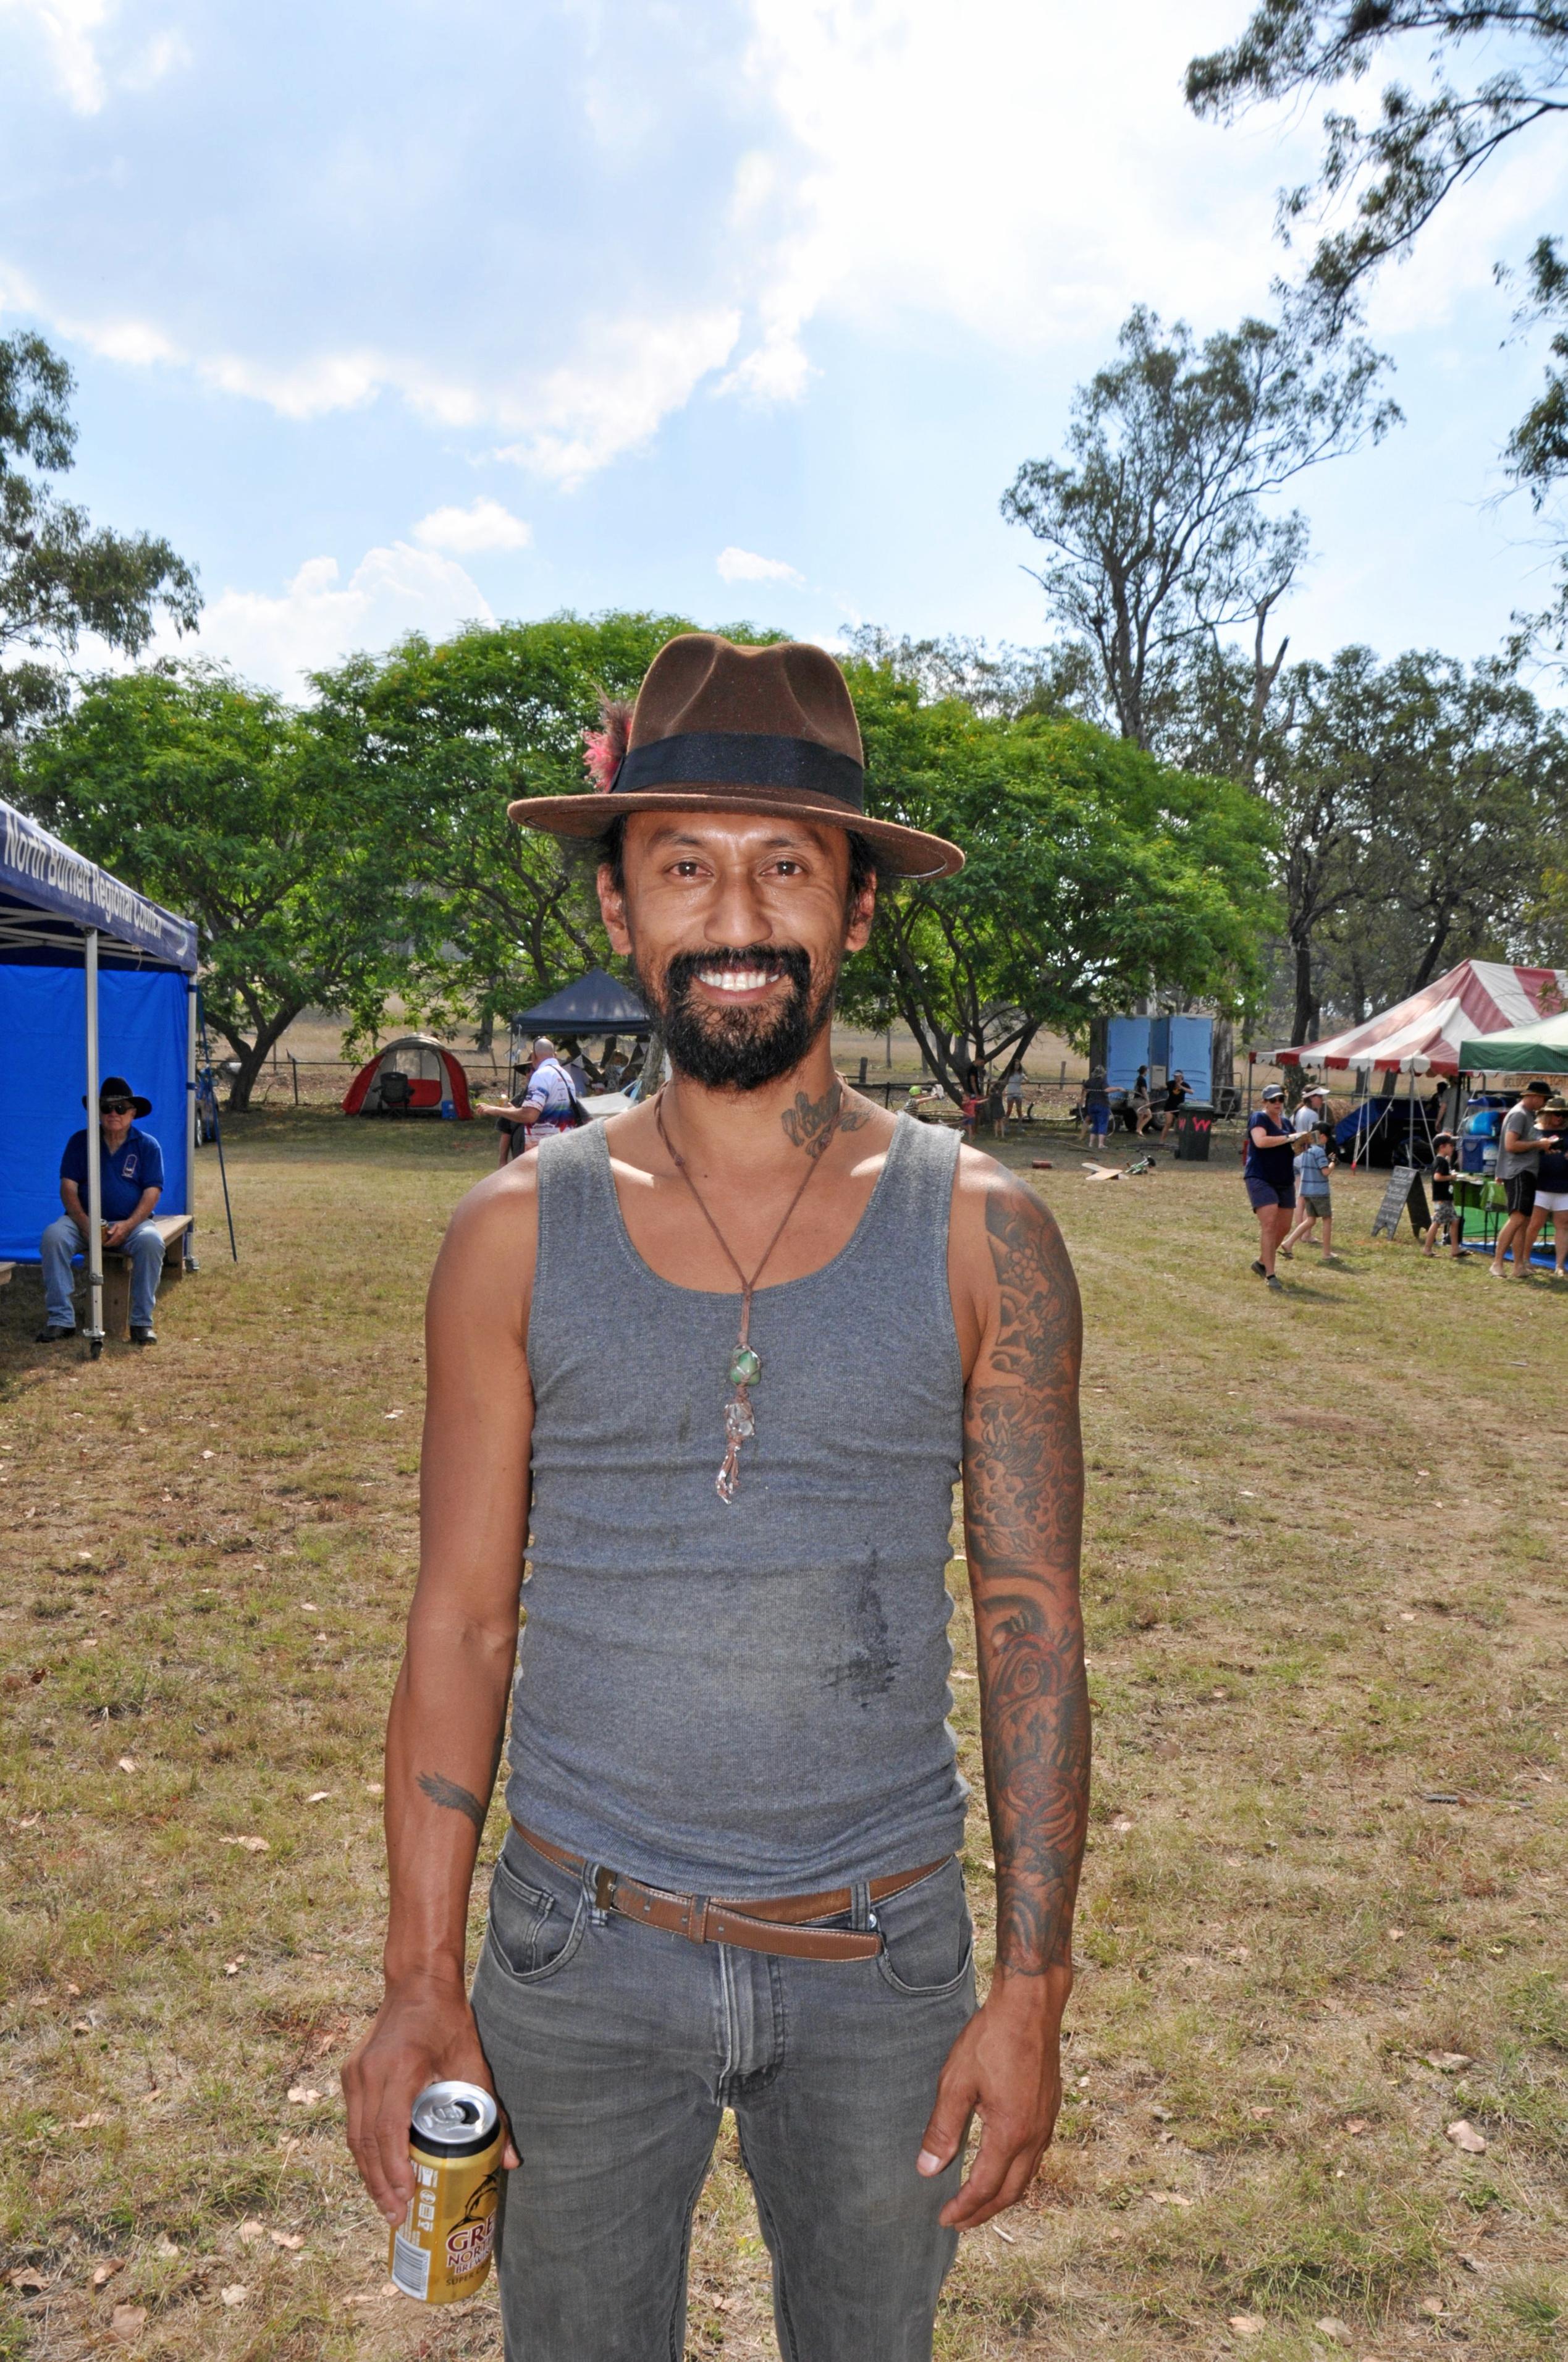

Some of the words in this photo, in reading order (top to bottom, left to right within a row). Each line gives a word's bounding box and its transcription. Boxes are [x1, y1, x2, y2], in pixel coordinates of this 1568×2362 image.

[4, 810, 47, 881] North
[48, 847, 91, 902] Burnett
[93, 866, 132, 923] Regional
[133, 896, 161, 939] Council
[1192, 1116, 1211, 1132] W
[445, 2273, 474, 2286] SUPER
